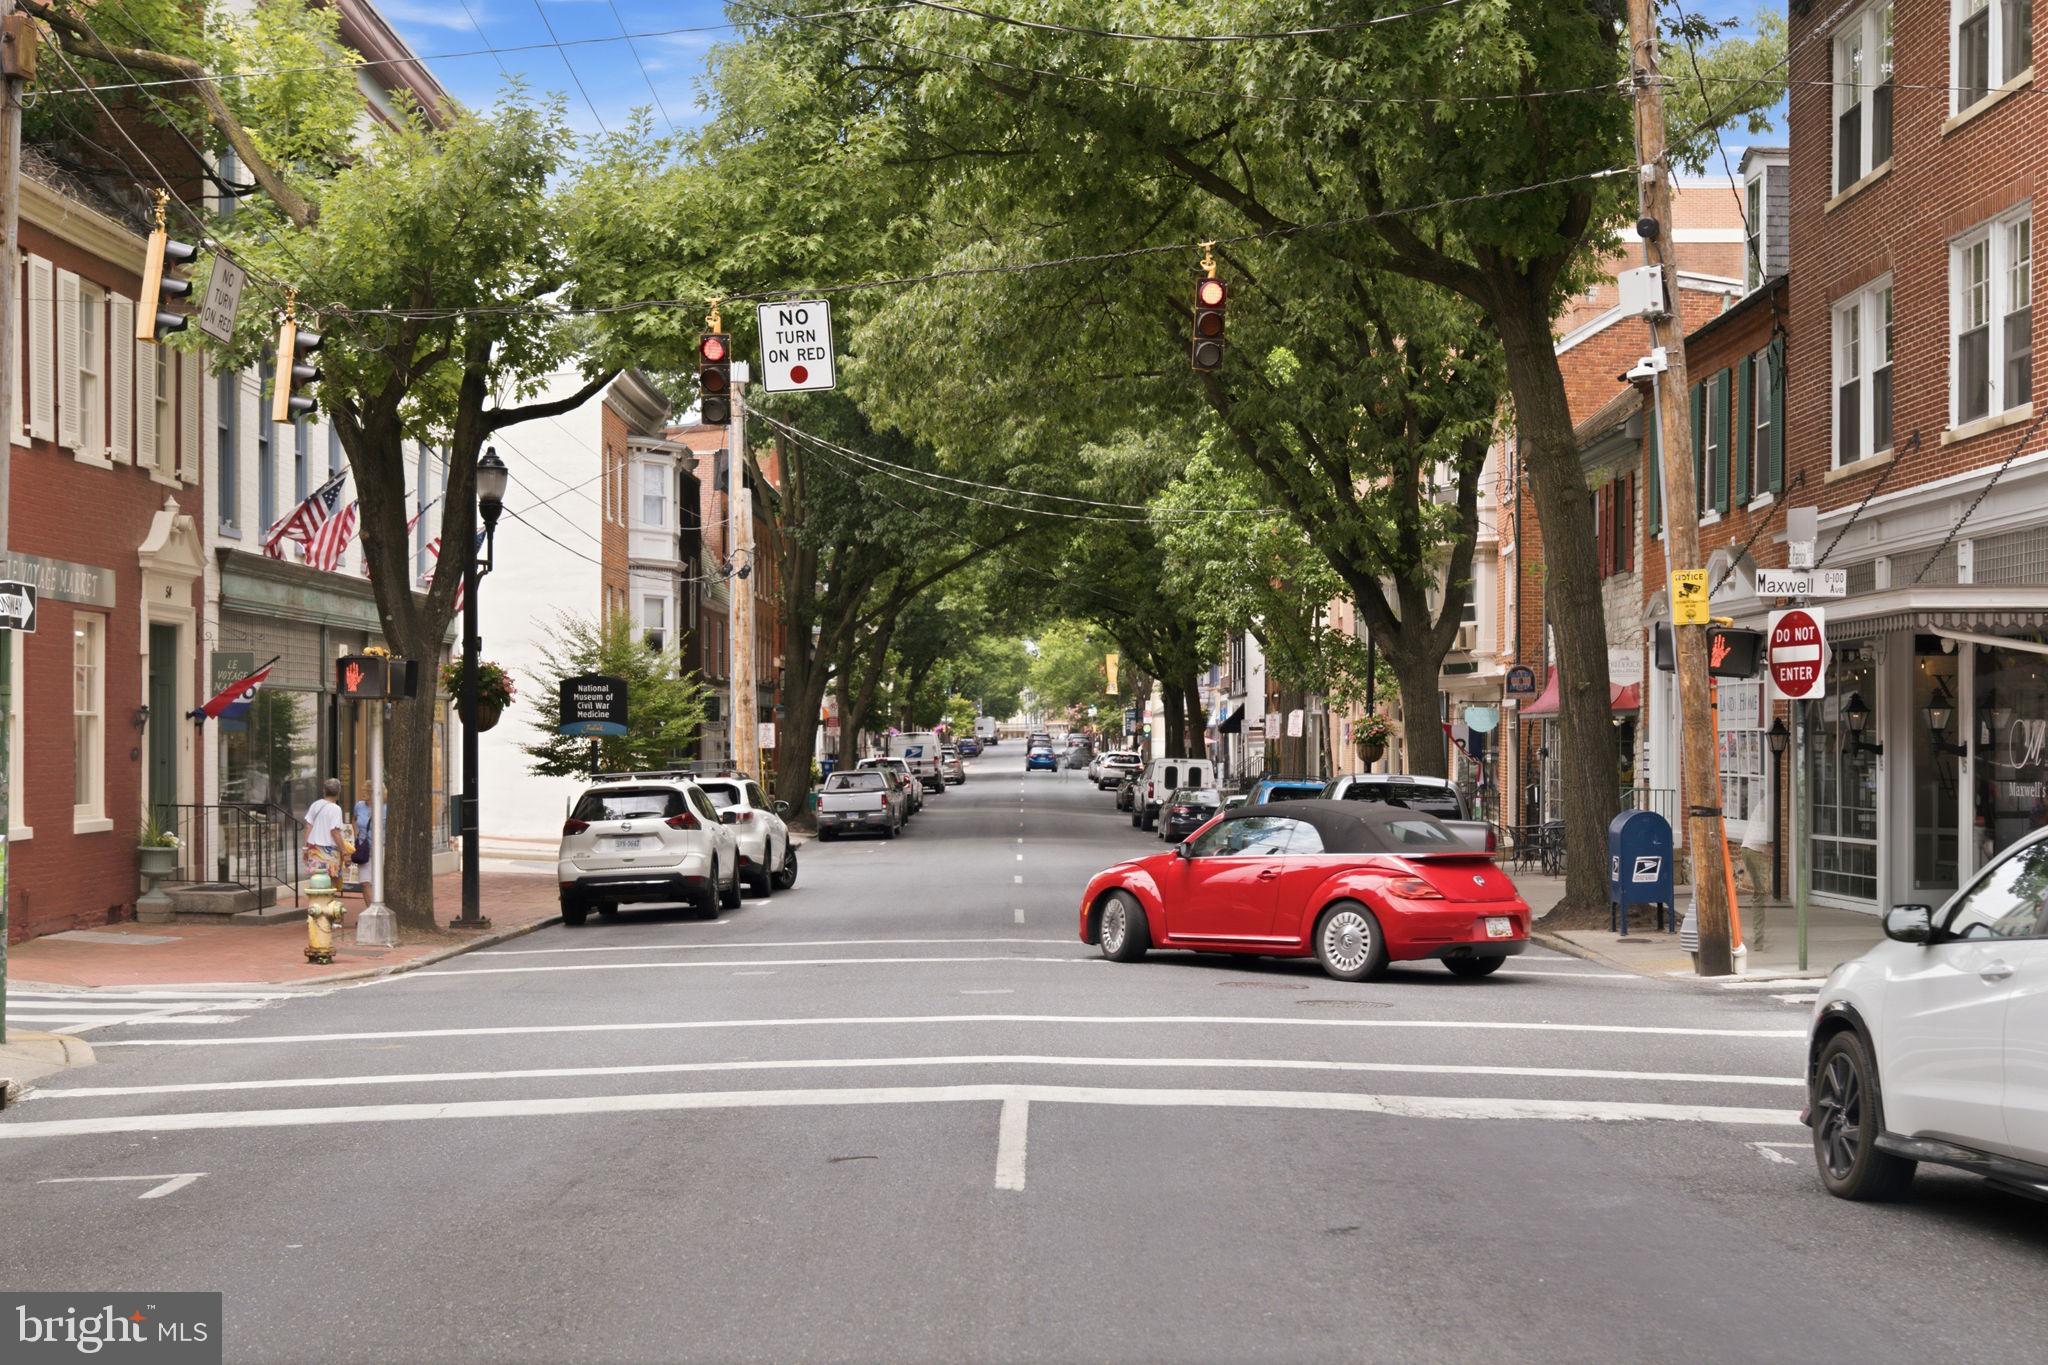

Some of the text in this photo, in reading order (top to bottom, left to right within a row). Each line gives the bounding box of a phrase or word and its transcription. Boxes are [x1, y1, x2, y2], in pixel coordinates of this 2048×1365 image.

[222, 269, 235, 288] NO
[214, 288, 234, 311] TURN
[204, 307, 232, 333] ON RED
[779, 308, 809, 326] NO
[776, 329, 816, 345] TURN
[768, 346, 825, 363] ON RED
[59, 569, 98, 598] MARKET
[1757, 573, 1814, 594] Maxwell
[1824, 572, 1845, 583] 0-100
[1830, 584, 1845, 593] Ave
[1776, 626, 1815, 643] DO NOT
[227, 660, 239, 669] LE
[1780, 666, 1813, 682] ENTER
[578, 684, 609, 692] National
[573, 693, 614, 701] Museum of
[577, 702, 610, 710] Civil War
[577, 710, 610, 718] Medicine
[2008, 781, 2047, 798] Maxwell's
